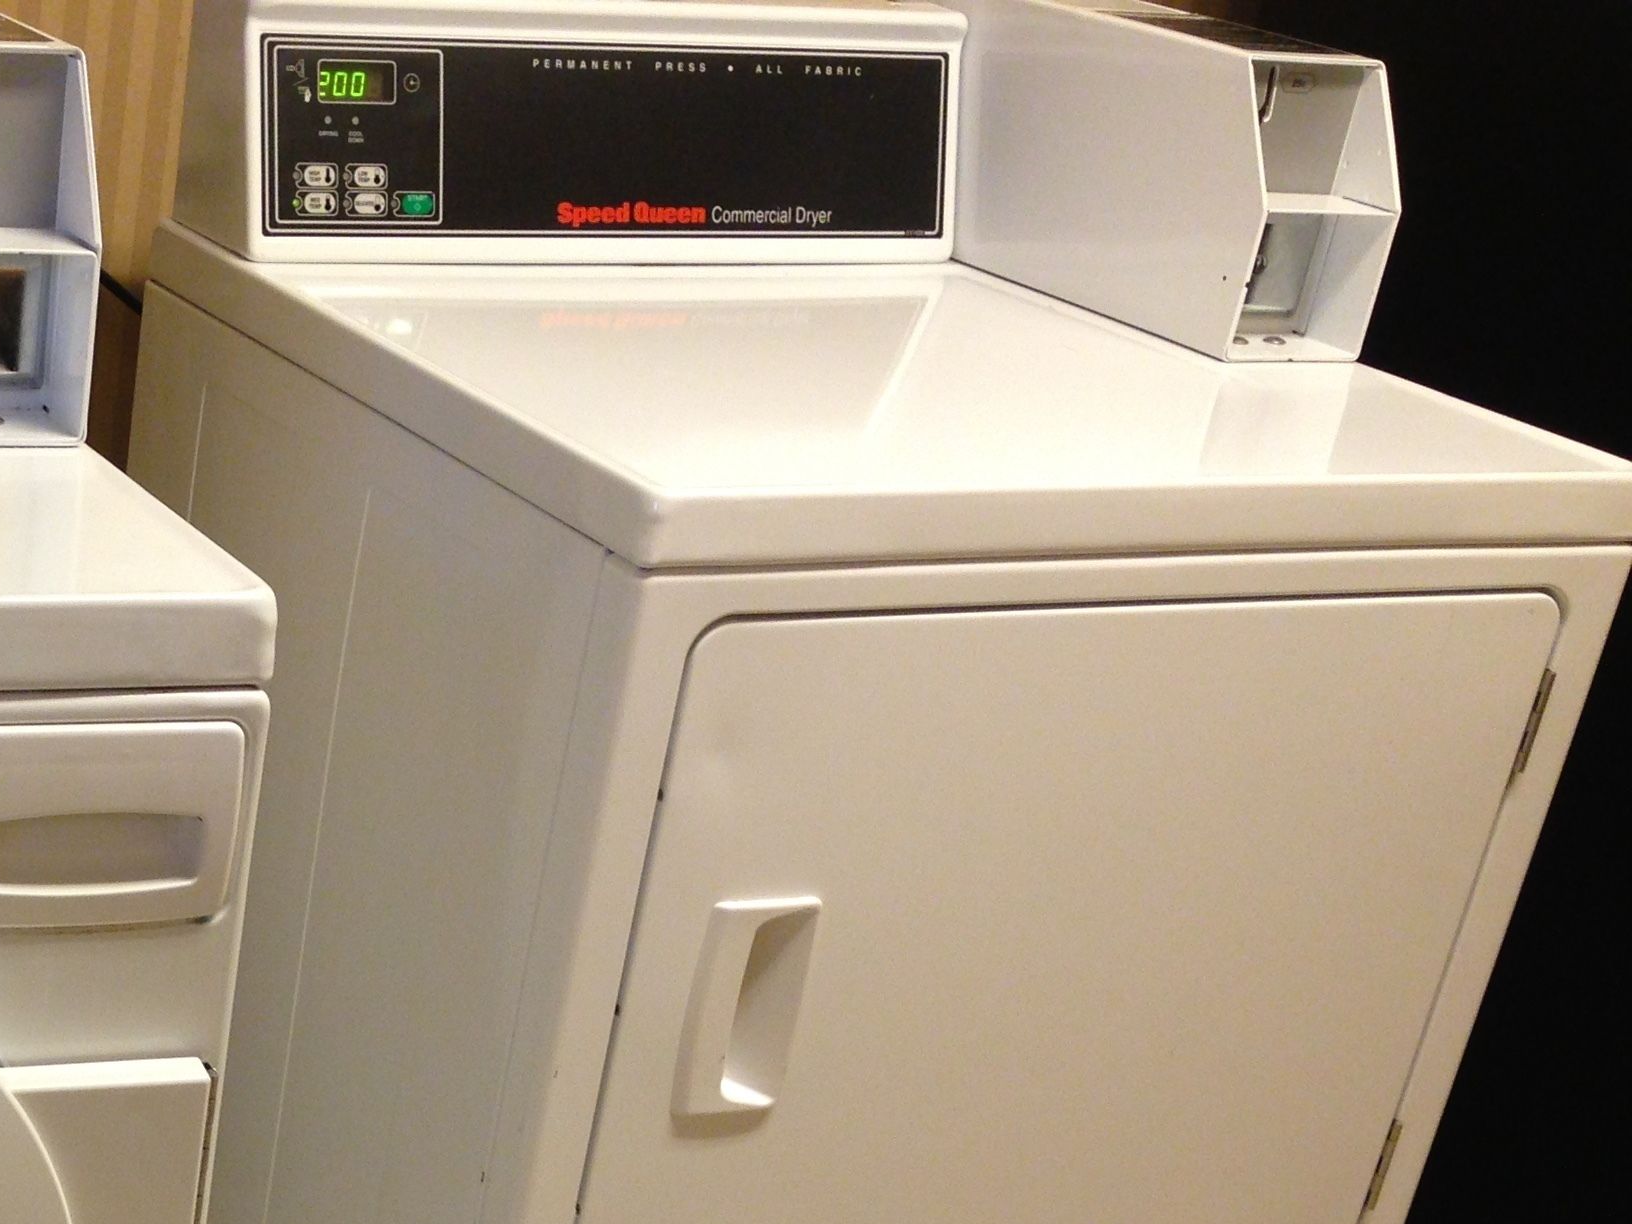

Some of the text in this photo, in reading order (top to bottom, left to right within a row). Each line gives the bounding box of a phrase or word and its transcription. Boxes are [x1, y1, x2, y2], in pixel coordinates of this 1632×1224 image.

[532, 58, 863, 77] PERMANENT PRESS ALL FABRIC
[319, 71, 366, 97] 200
[557, 201, 832, 227] Speed Queen Commercial Dryer
